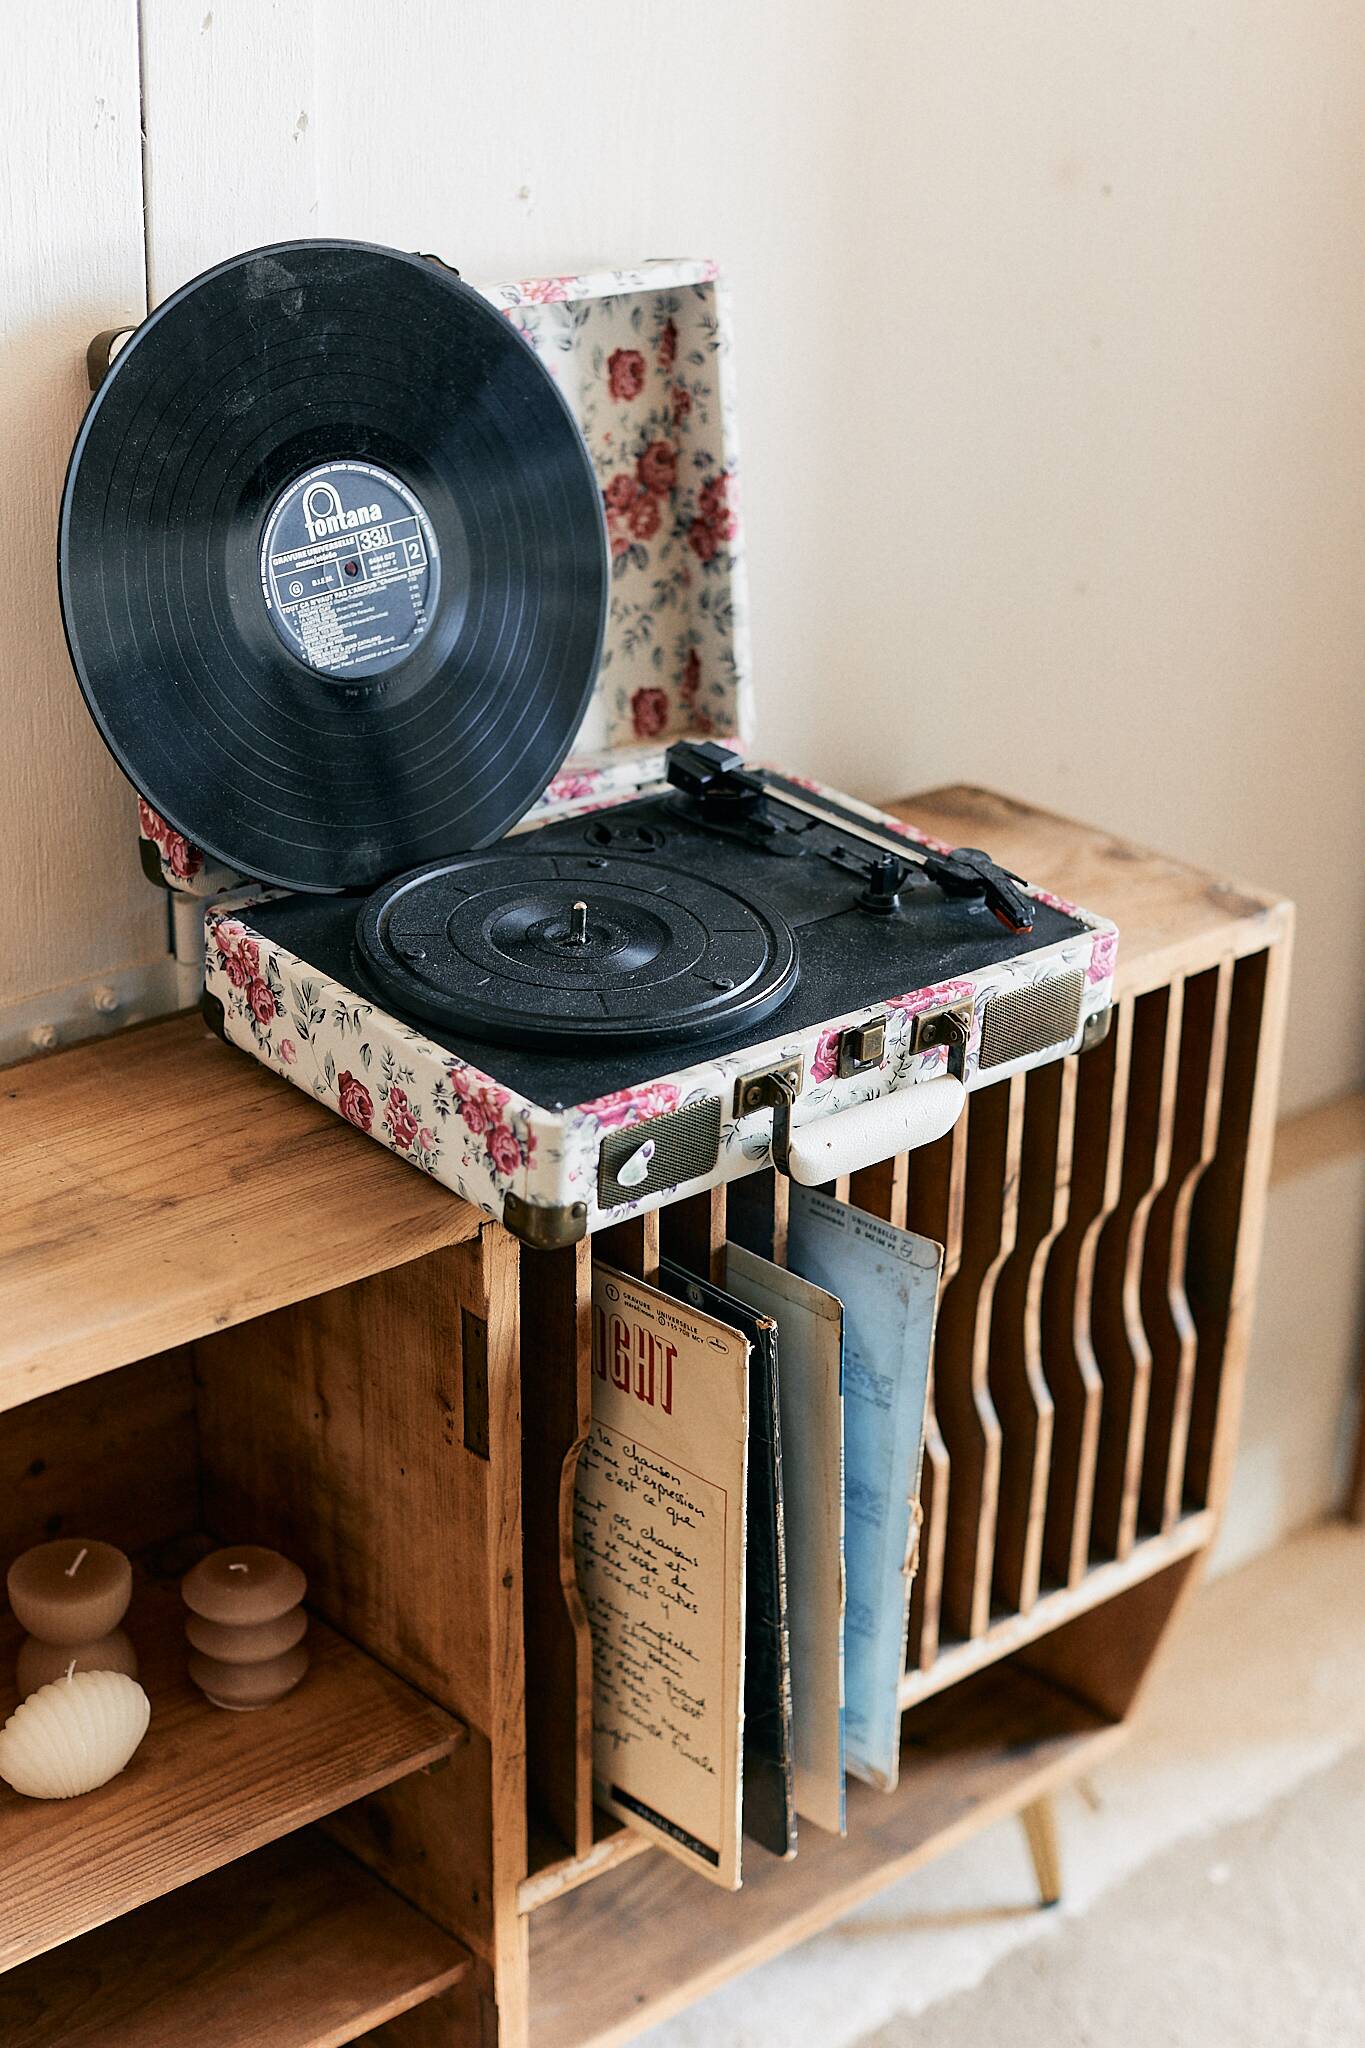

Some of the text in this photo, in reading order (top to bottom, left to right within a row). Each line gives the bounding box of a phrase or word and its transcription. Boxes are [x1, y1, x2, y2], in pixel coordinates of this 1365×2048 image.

[304, 503, 383, 543] fontana
[272, 536, 355, 566] GRAVURE UNIVERSELLE
[408, 542, 421, 560] 2
[282, 604, 299, 614] TOUT
[333, 589, 348, 600] PAS
[811, 1197, 845, 1217] GRAVURE
[852, 1215, 897, 1242] UNIVERSELLE
[623, 1291, 651, 1310] GRAVURE
[656, 1309, 698, 1334] UNIVERSELLE
[666, 1506, 696, 1529] que
